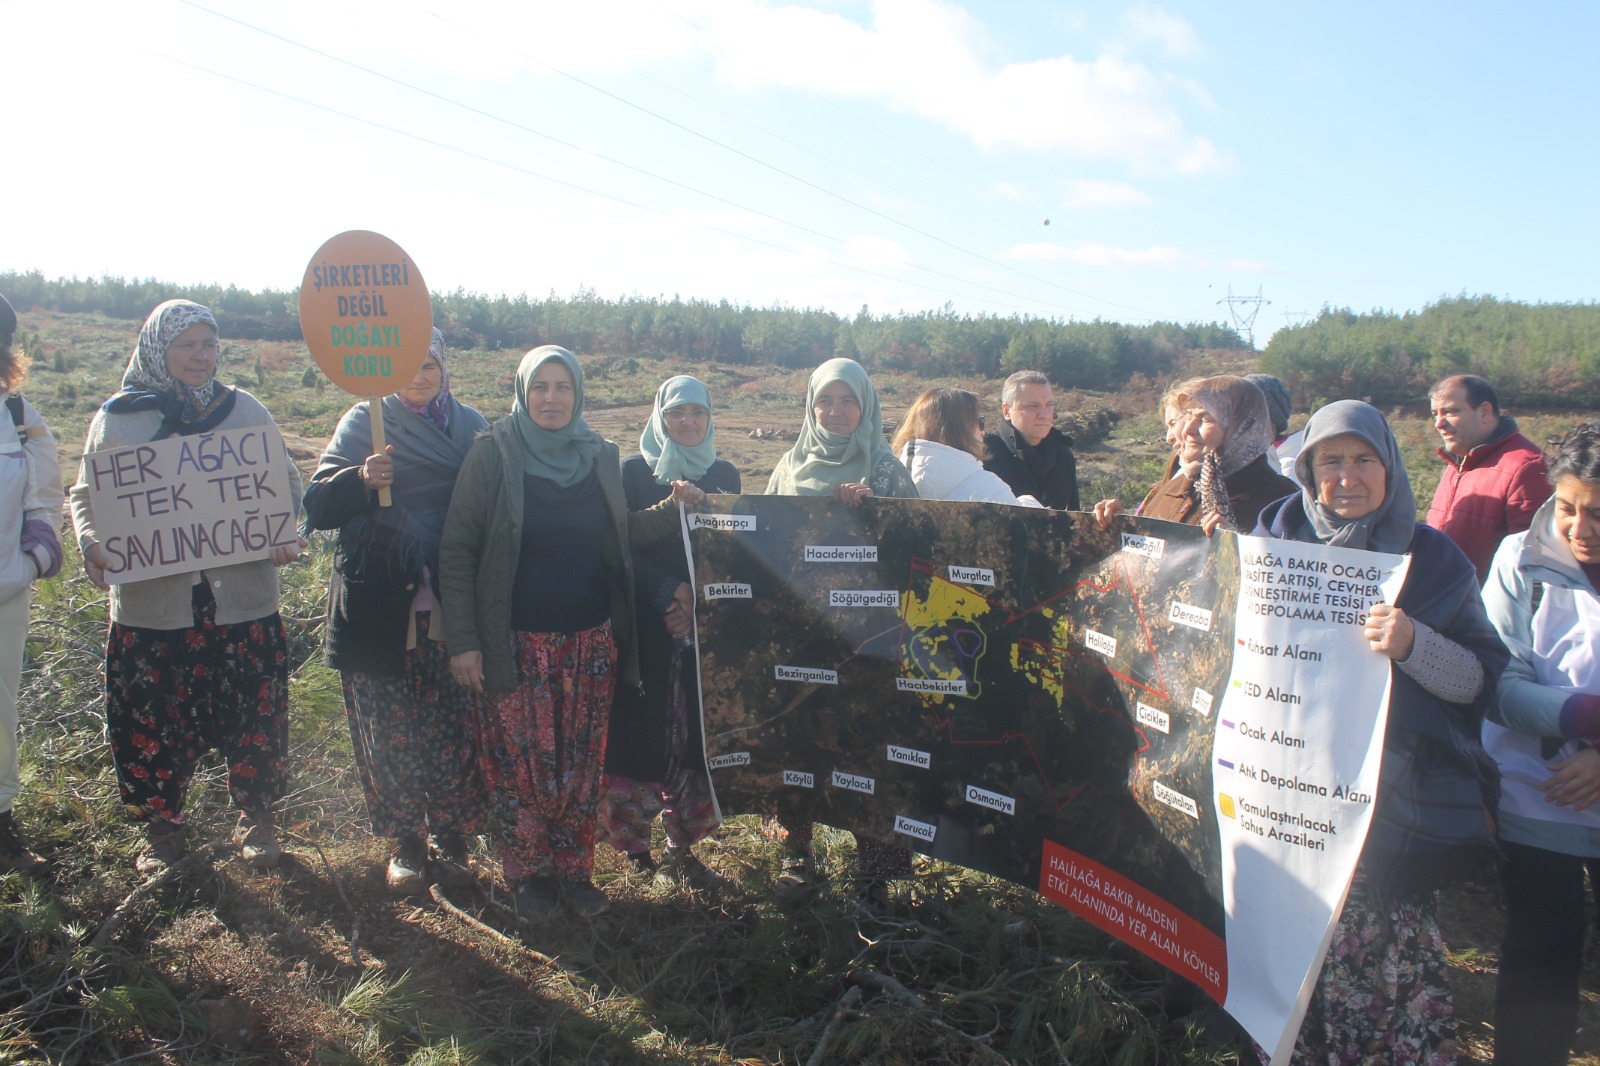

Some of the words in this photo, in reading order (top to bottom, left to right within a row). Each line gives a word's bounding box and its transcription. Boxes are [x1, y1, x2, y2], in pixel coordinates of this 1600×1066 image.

[313, 258, 409, 292] ŞİRKETLERİ
[337, 290, 388, 317] DEĞİL
[330, 320, 400, 348] DOĞAYI
[343, 355, 393, 377] KORU
[91, 445, 163, 492] HER
[177, 431, 271, 476] AĞACI
[117, 482, 194, 518] TEK
[207, 470, 278, 503] TEK
[694, 515, 748, 530] Aşağışapçı
[105, 508, 298, 574] SAVUNACAĞIZ
[806, 548, 876, 561] Hacıdervişler
[952, 569, 992, 582] Muratlar
[1288, 557, 1328, 574] BAKIR
[1332, 563, 1381, 581] OCAĞI
[708, 586, 748, 596] Bekirler
[1277, 573, 1322, 591] ARTIŞI,
[1327, 579, 1379, 597] CEVHER
[832, 592, 896, 605] Söğütgediği
[1325, 593, 1364, 610] TESİSİ
[1172, 606, 1209, 626] Dereoba
[1255, 602, 1326, 622] DEPOLAMA
[1088, 633, 1114, 654] Halilağa
[1282, 644, 1322, 662] Alanı
[778, 668, 835, 681] Bezirganlar
[899, 680, 963, 692] Hacıbekirler
[1265, 686, 1302, 705] Alanı
[1139, 707, 1167, 728] Cicikler
[1239, 722, 1266, 741] Ocak
[1270, 730, 1305, 749] Alanı
[710, 754, 749, 767] Yeniköy
[891, 748, 928, 765] Yanıklar
[786, 773, 812, 785] Köylü
[835, 774, 873, 791] Yaylacık
[1239, 762, 1257, 780] Atık
[1261, 769, 1327, 797] Depolama
[1332, 785, 1371, 804] Alanı
[969, 789, 1012, 812] Osmaniye
[1238, 796, 1336, 835] Kamulaştırılacak
[898, 819, 933, 838] Korucak
[1240, 815, 1264, 837] Şahıs
[1268, 826, 1325, 851] Arazileri
[1050, 856, 1101, 892] HALİLAĞA
[1104, 881, 1133, 909] BAKIR
[1136, 901, 1178, 936] MADENİ
[1048, 874, 1068, 895] ETKİ
[1070, 888, 1124, 927] ALANINDA
[1129, 916, 1147, 939] YER
[1150, 930, 1180, 959] ALAN
[1184, 949, 1220, 987] KÖYLER
